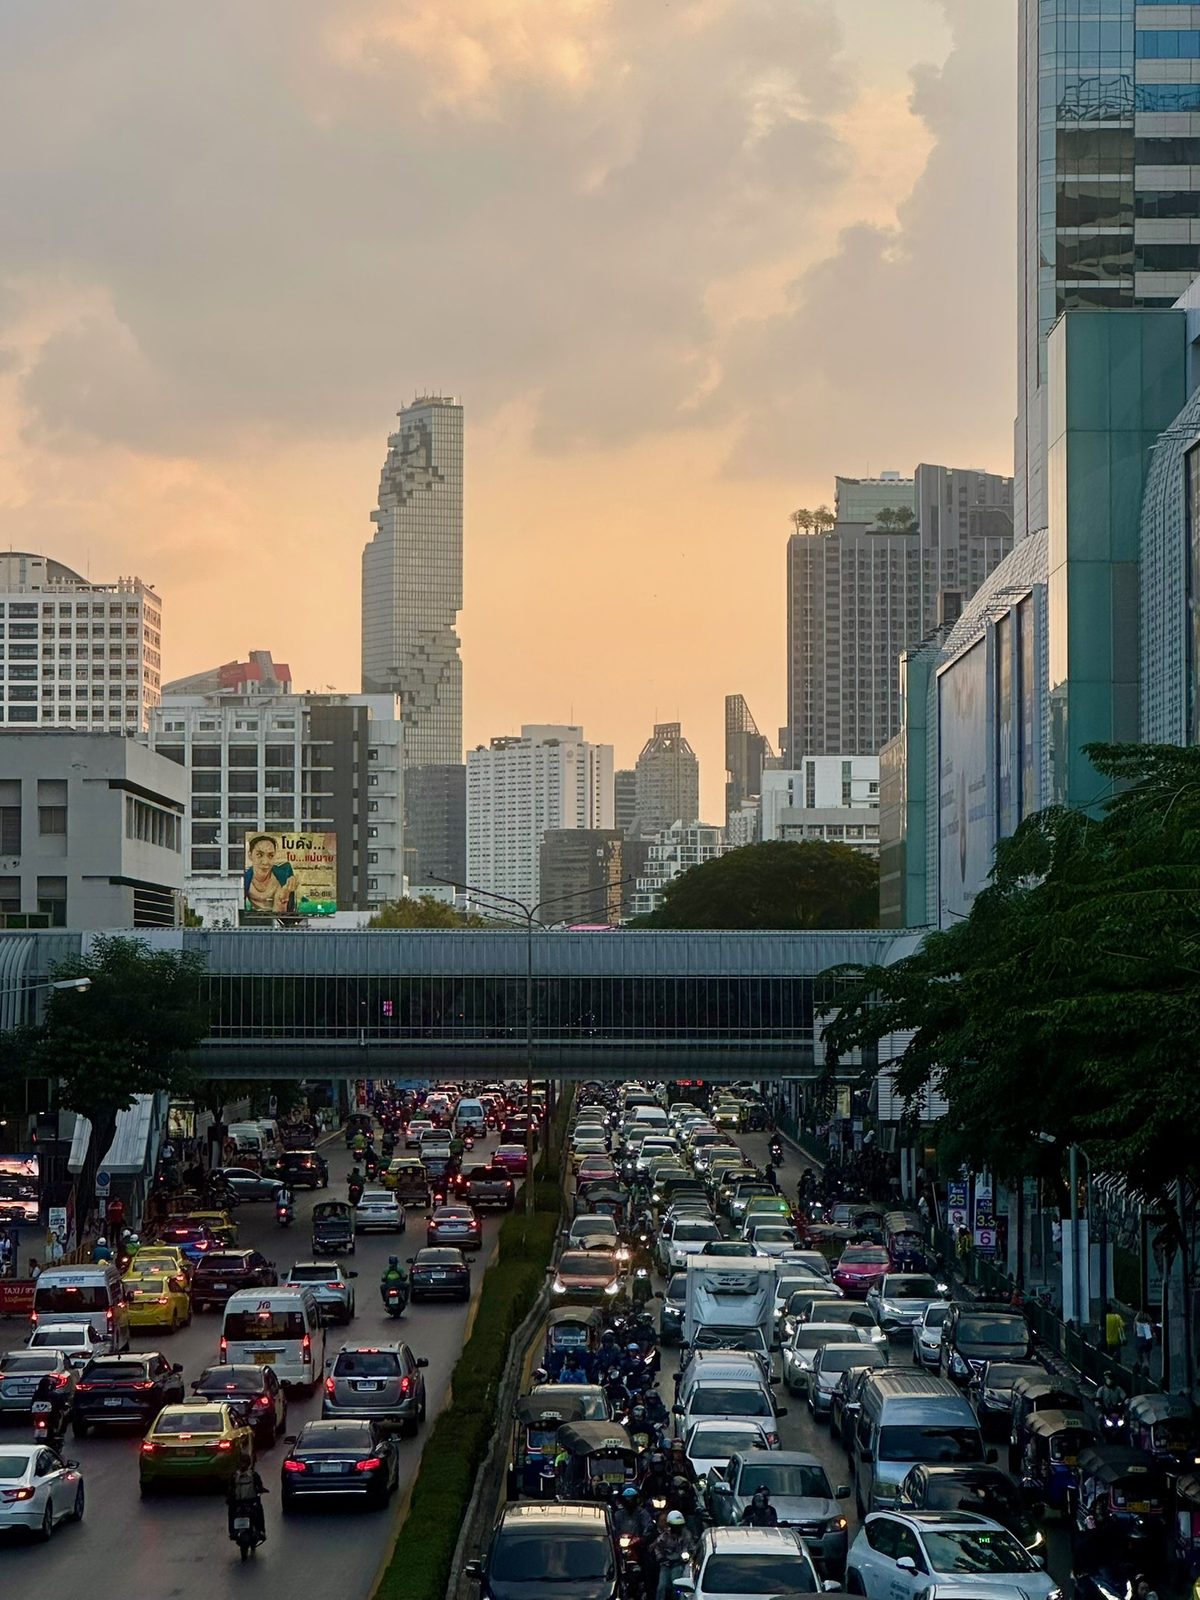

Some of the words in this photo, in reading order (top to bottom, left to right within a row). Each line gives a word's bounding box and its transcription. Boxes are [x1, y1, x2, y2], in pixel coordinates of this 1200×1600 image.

[949, 1194, 965, 1206] 25
[980, 1231, 991, 1244] 6
[3, 1287, 20, 1295] TAXI
